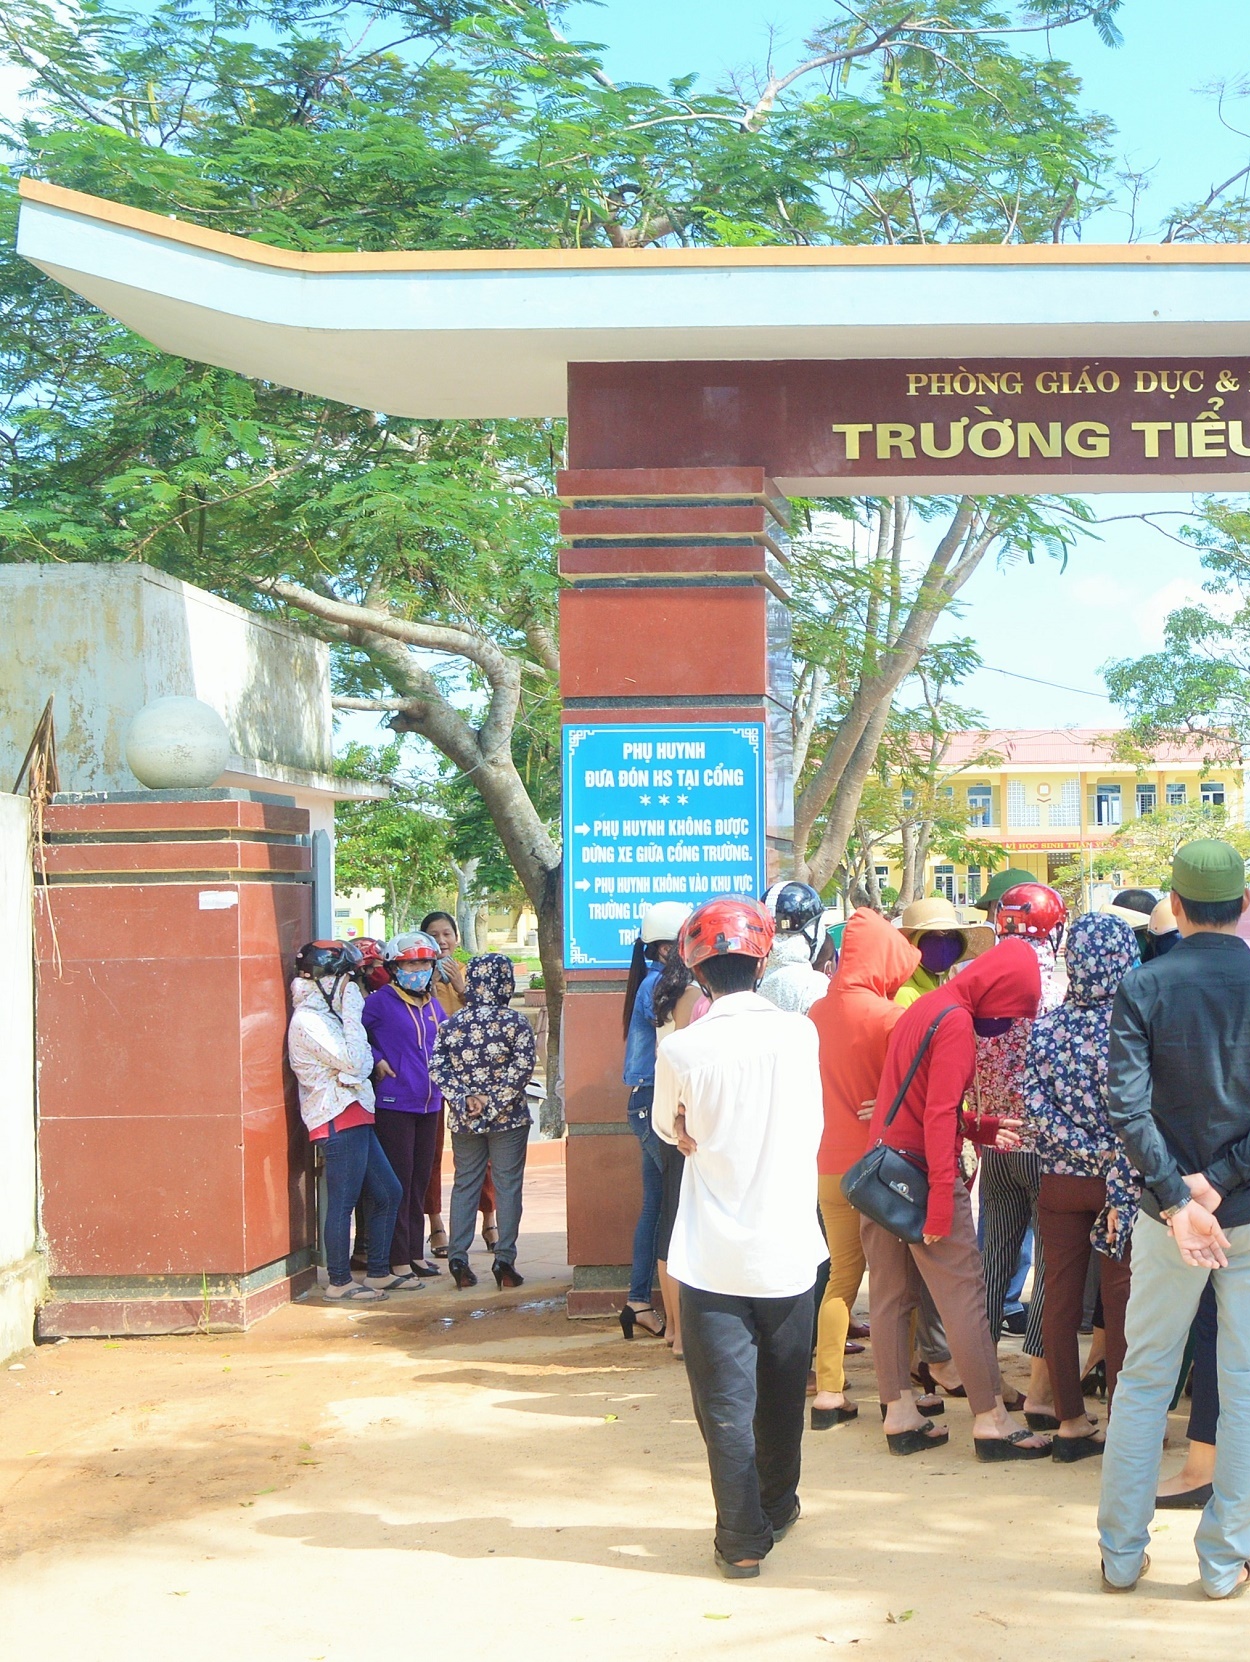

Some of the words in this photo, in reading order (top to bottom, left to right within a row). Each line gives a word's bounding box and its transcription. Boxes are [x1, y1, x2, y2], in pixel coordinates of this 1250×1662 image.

[906, 366, 1024, 396] PHÒNG
[1035, 366, 1120, 394] GIÁO
[1134, 370, 1204, 399] DỤC
[1214, 369, 1240, 392] &
[832, 405, 1110, 460] TRƯỜNG
[623, 742, 652, 763] PHỤ
[656, 742, 705, 760] HUYNH
[585, 768, 615, 788] ĐƯA
[618, 767, 649, 788] ĐÓN
[653, 769, 673, 787] HS
[676, 769, 700, 790] TẠI
[703, 763, 744, 787] CỔNG
[593, 820, 619, 840] PHỤ
[622, 819, 665, 837] HUYNH
[668, 816, 711, 836] KHÔNG
[715, 817, 749, 838] ĐƯỢC
[581, 842, 615, 863] DỪNG
[617, 846, 633, 862] XE
[636, 842, 665, 863] GIỮA
[666, 839, 700, 862] CỔNG
[1041, 841, 1064, 849] SINH
[594, 876, 615, 897] PHỤ
[617, 876, 650, 893] HUYNH
[652, 873, 687, 893] KHÔNG
[689, 872, 708, 892] VÀO
[710, 875, 731, 892] KHU
[733, 874, 753, 897] VỰC
[588, 898, 631, 920] TRƯỜNG
